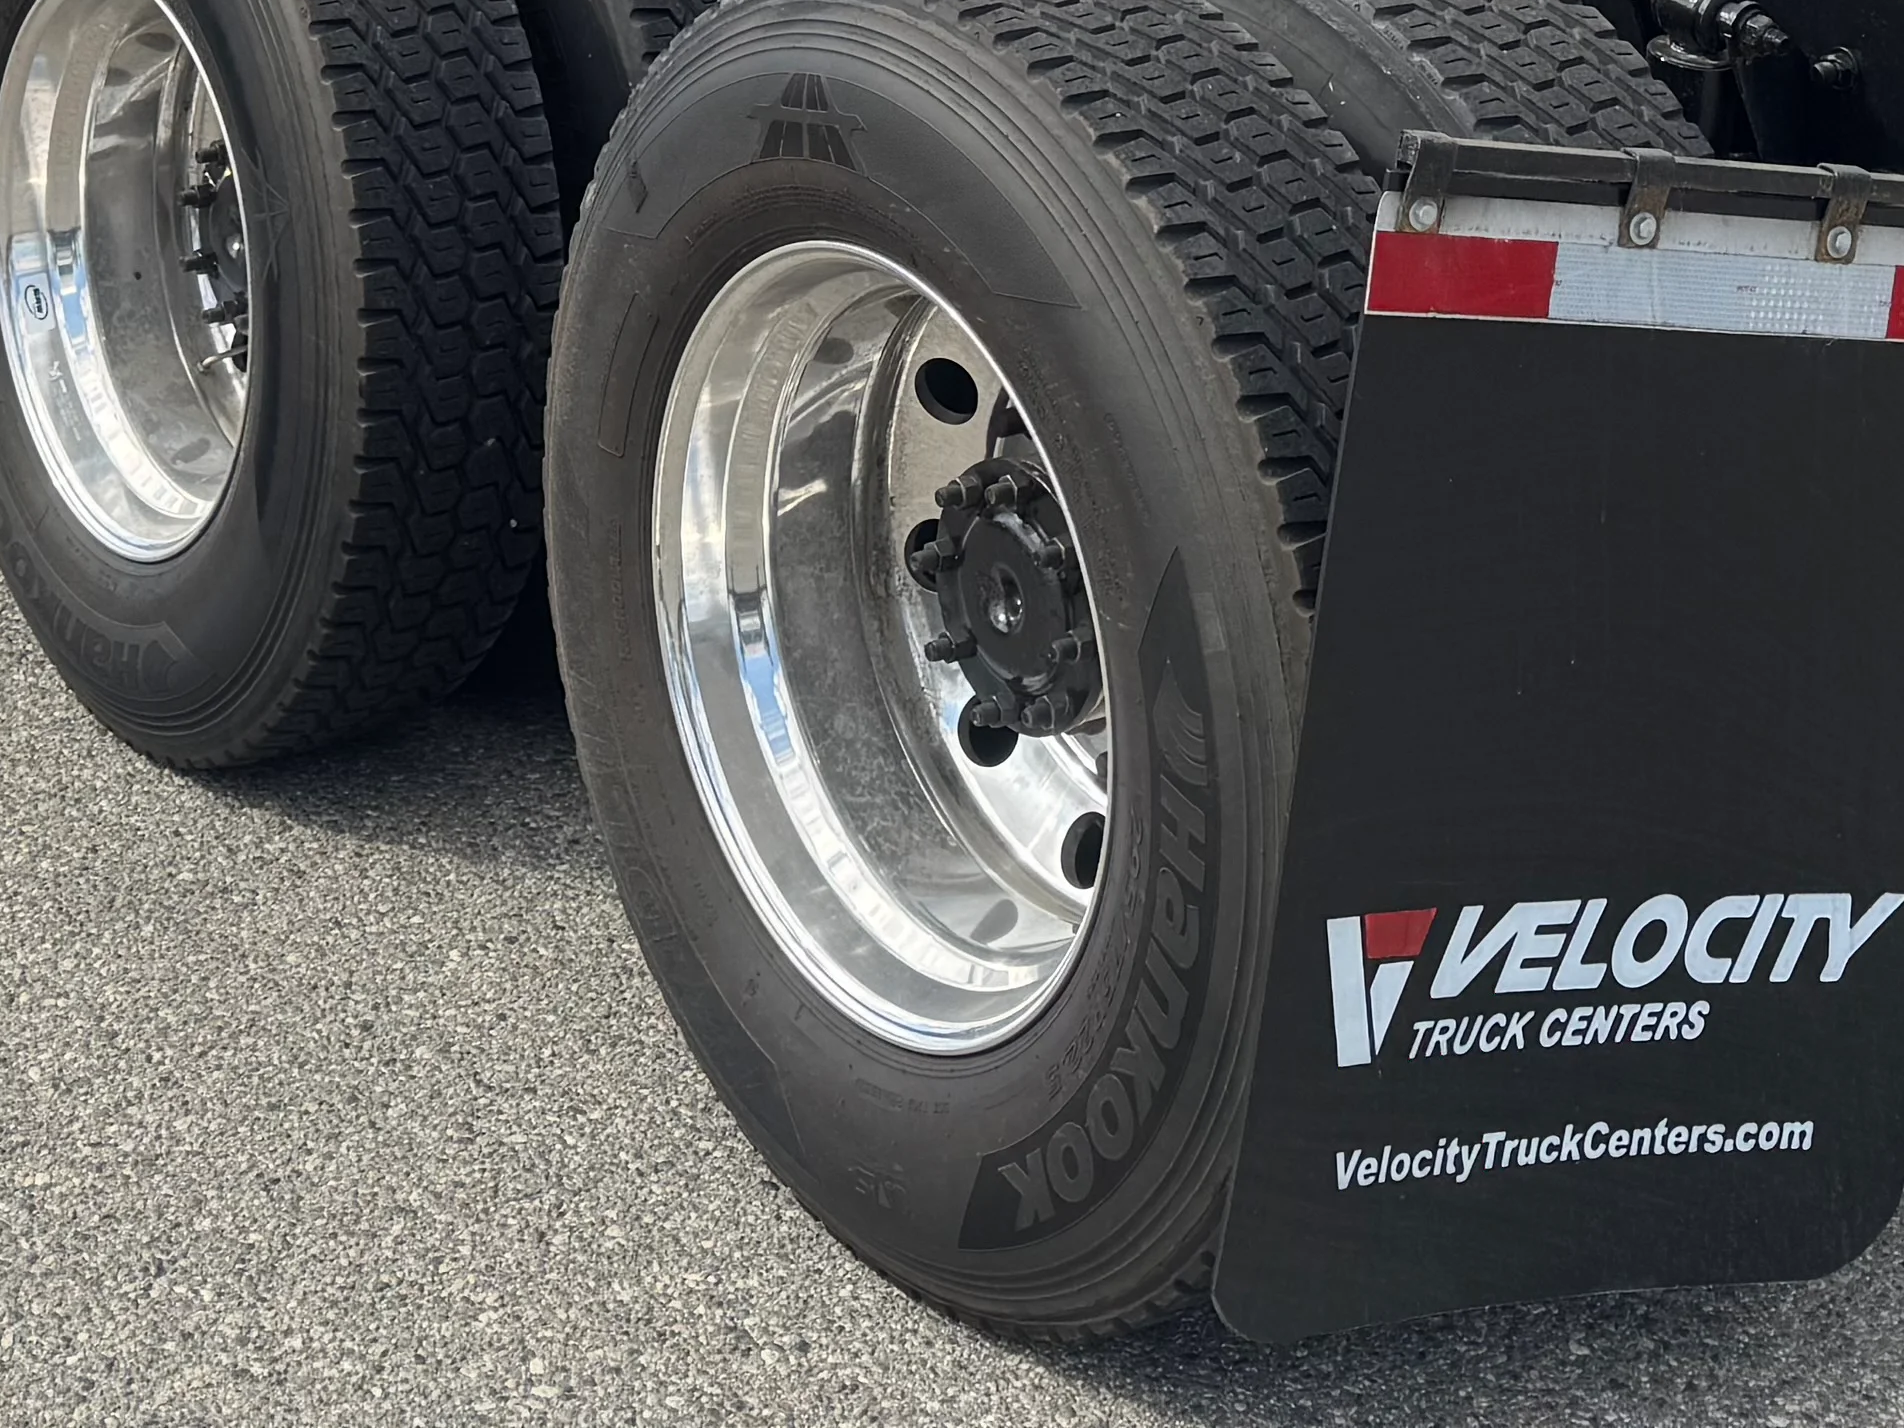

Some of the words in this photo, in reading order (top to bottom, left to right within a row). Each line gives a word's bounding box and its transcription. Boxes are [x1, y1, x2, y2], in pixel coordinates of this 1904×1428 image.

[1407, 1007, 1531, 1062] TRUCK
[1538, 998, 1712, 1051] CENTERS
[1334, 1114, 1815, 1192] VelocityTruckCenters.com
